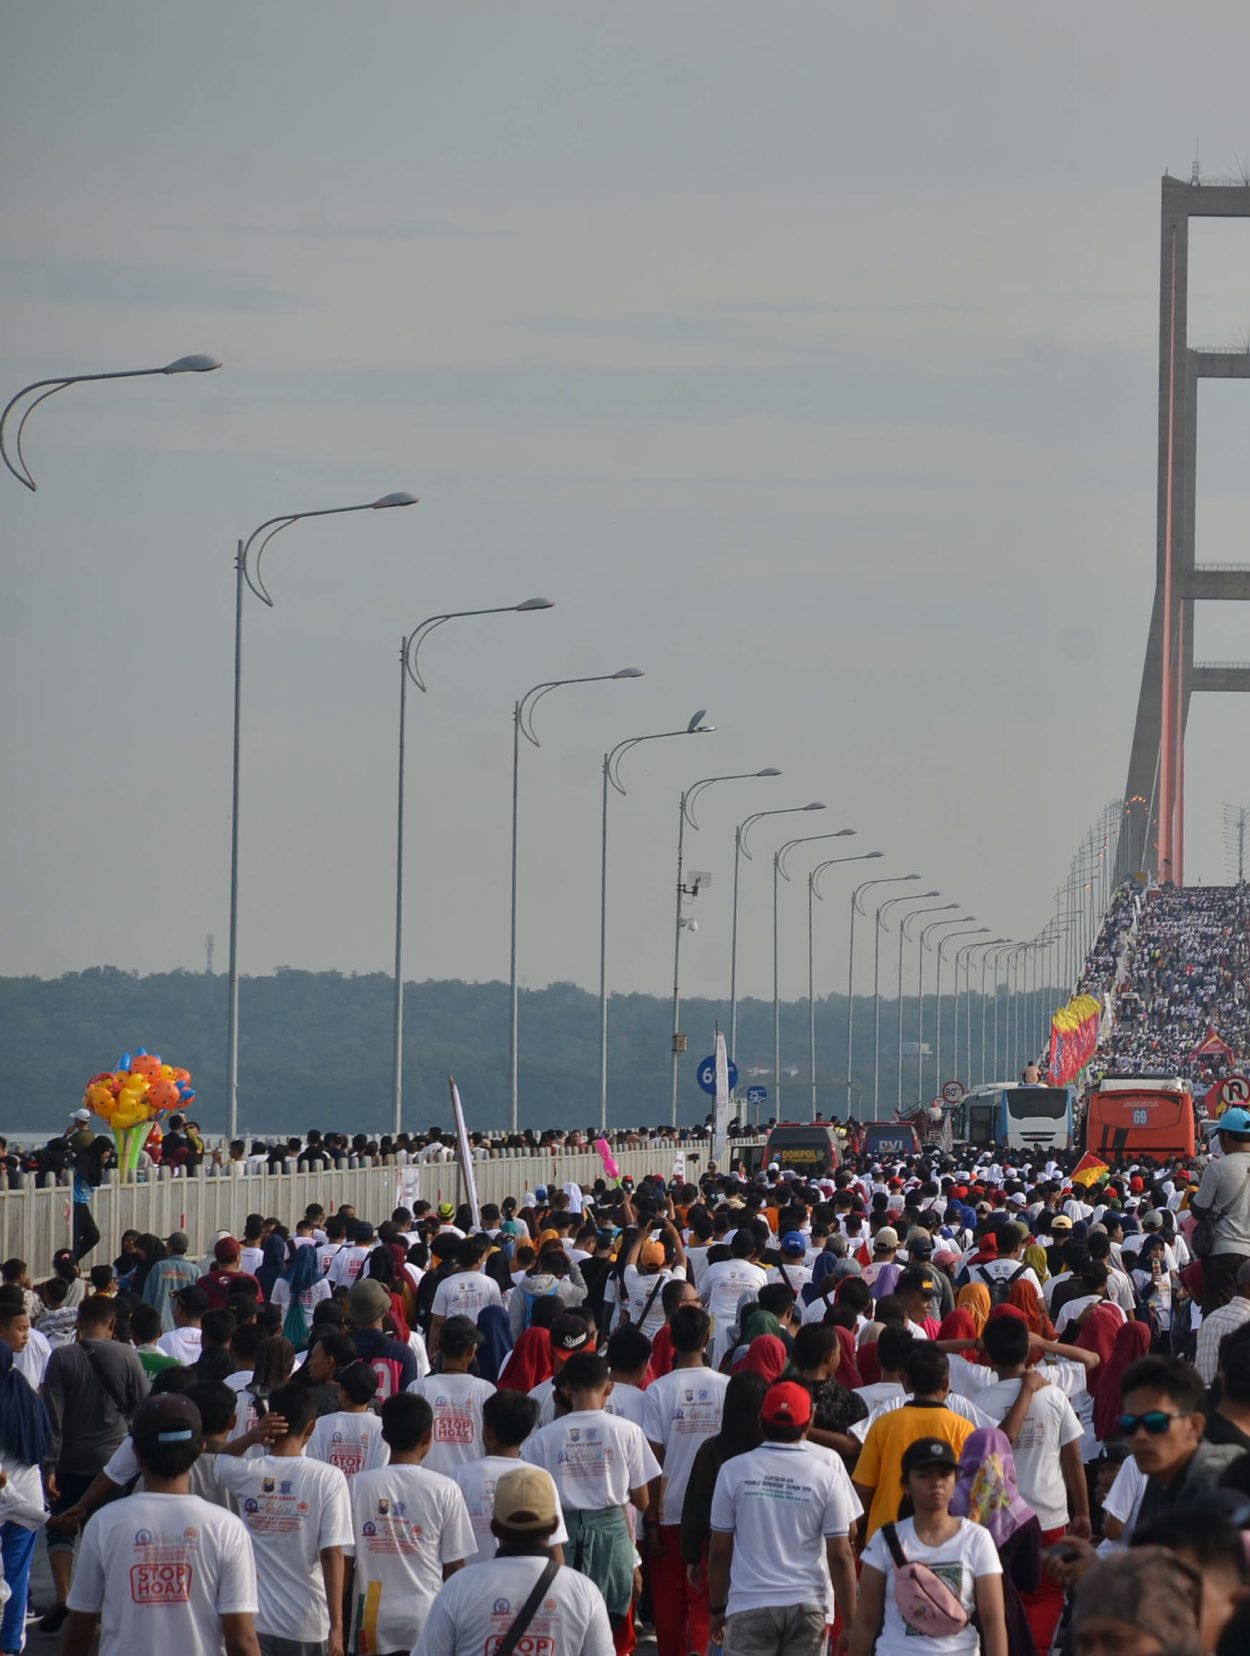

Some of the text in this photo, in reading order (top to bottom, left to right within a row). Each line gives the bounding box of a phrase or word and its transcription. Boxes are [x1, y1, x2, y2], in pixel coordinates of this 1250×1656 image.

[1132, 1108, 1148, 1125] 69
[438, 1418, 471, 1429] STOP
[438, 1428, 470, 1438] HOAX
[332, 1455, 362, 1467] STOP
[137, 1565, 187, 1582] STOP
[137, 1580, 187, 1595] HOAX
